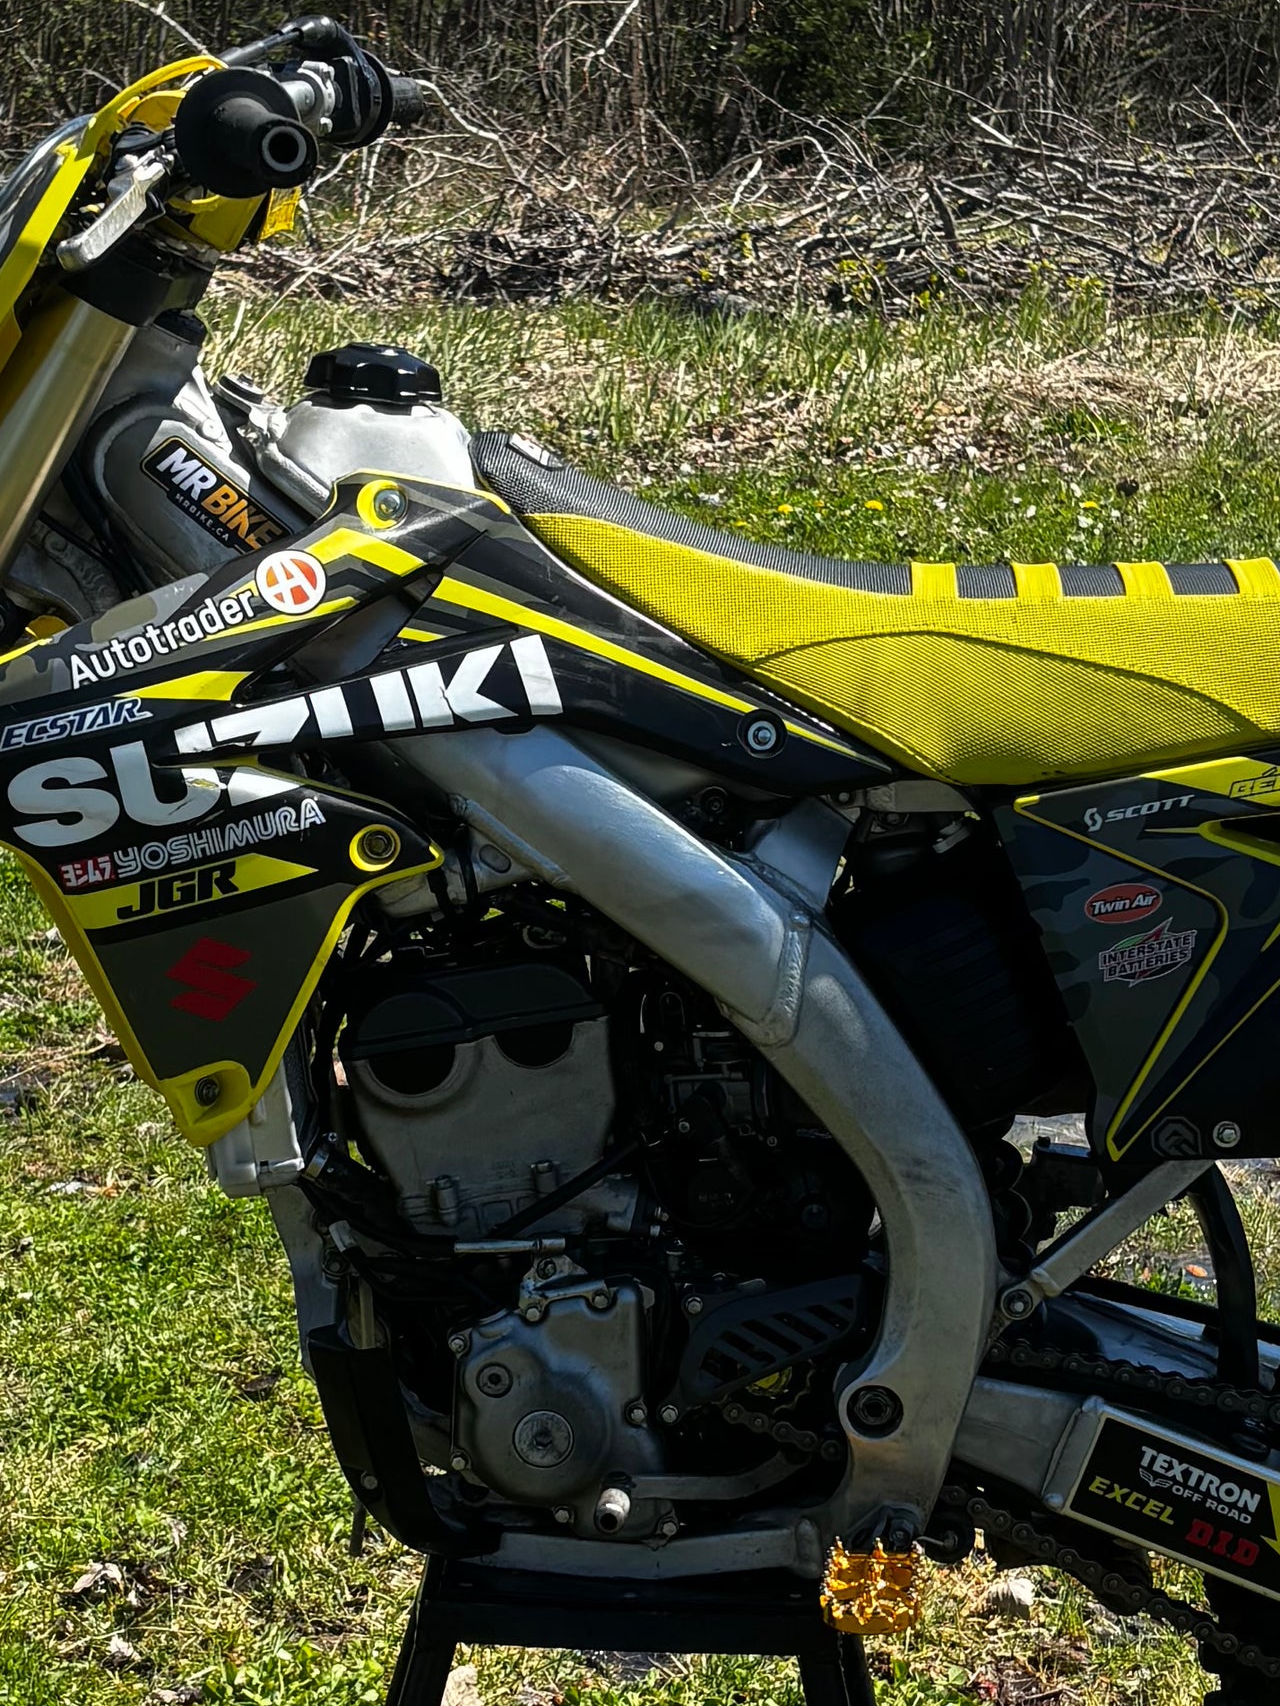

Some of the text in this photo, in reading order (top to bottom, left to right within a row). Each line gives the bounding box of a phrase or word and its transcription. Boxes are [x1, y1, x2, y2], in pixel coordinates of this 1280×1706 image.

[156, 447, 283, 551] MR BIKE
[70, 588, 256, 690] Autotrader
[7, 633, 564, 847] SUZUKI
[1104, 794, 1195, 823] SCOTT
[113, 797, 327, 879] YOSHIMURA
[116, 860, 240, 921] JGR
[1092, 893, 1158, 915] Twin Air
[1102, 934, 1192, 966] INTERSTATE
[1107, 949, 1189, 977] BATTERIES
[1088, 1475, 1175, 1526] EXCEL
[1140, 1445, 1262, 1514] TEXTRON
[1171, 1483, 1253, 1525] OFF ROAD
